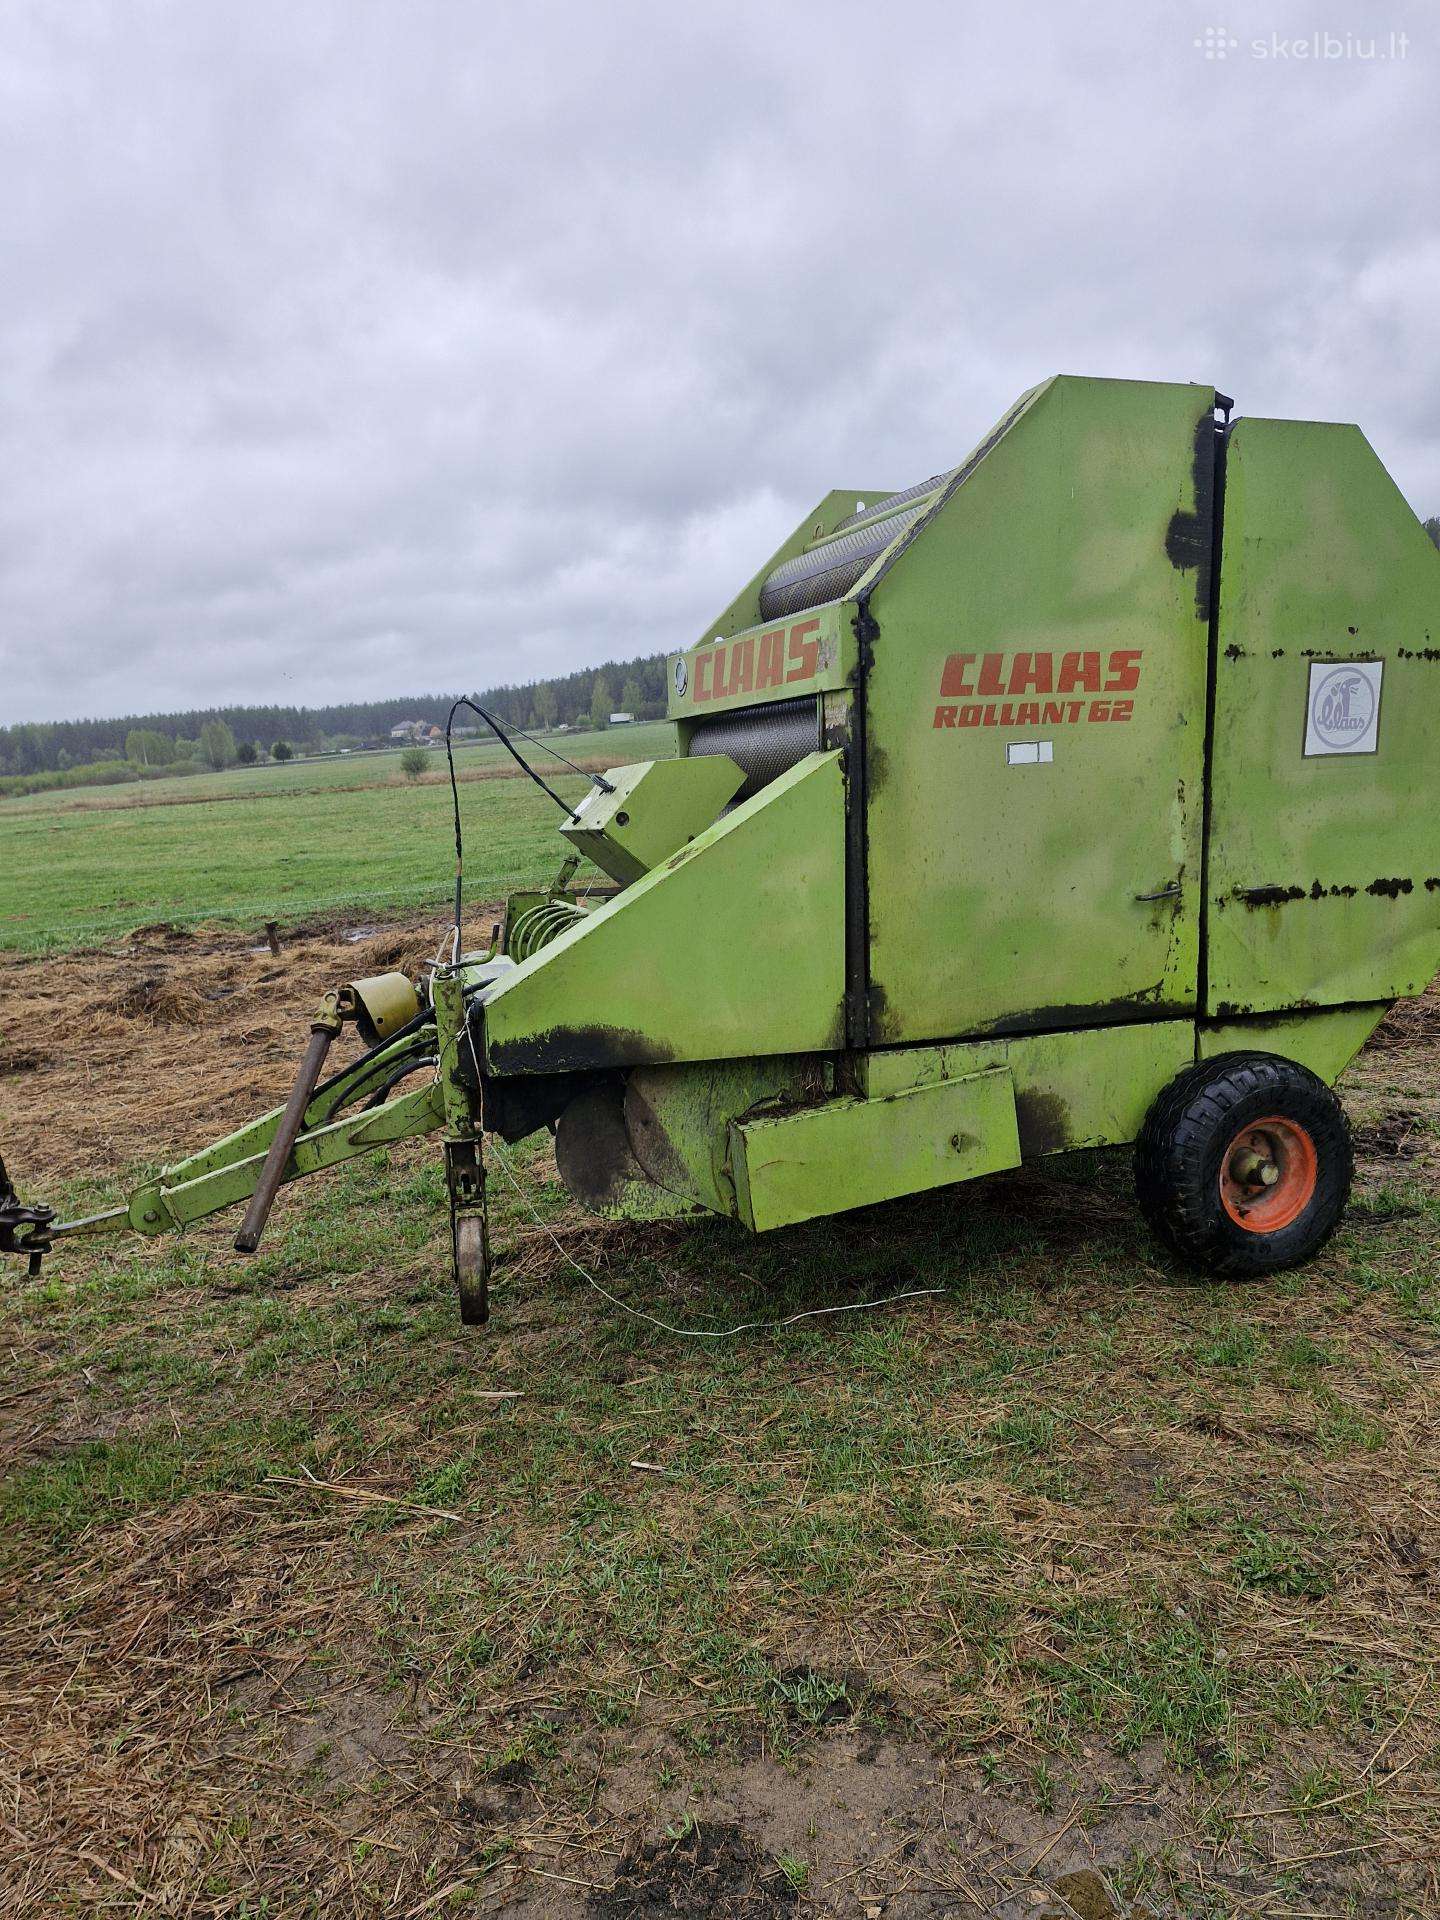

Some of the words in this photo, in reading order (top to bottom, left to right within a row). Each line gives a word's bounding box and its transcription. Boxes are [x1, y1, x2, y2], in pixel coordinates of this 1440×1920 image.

[692, 618, 820, 703] CLAAS
[940, 650, 1142, 697] CLAAS
[933, 701, 1085, 728] ROLLANT
[1088, 700, 1134, 722] 62
